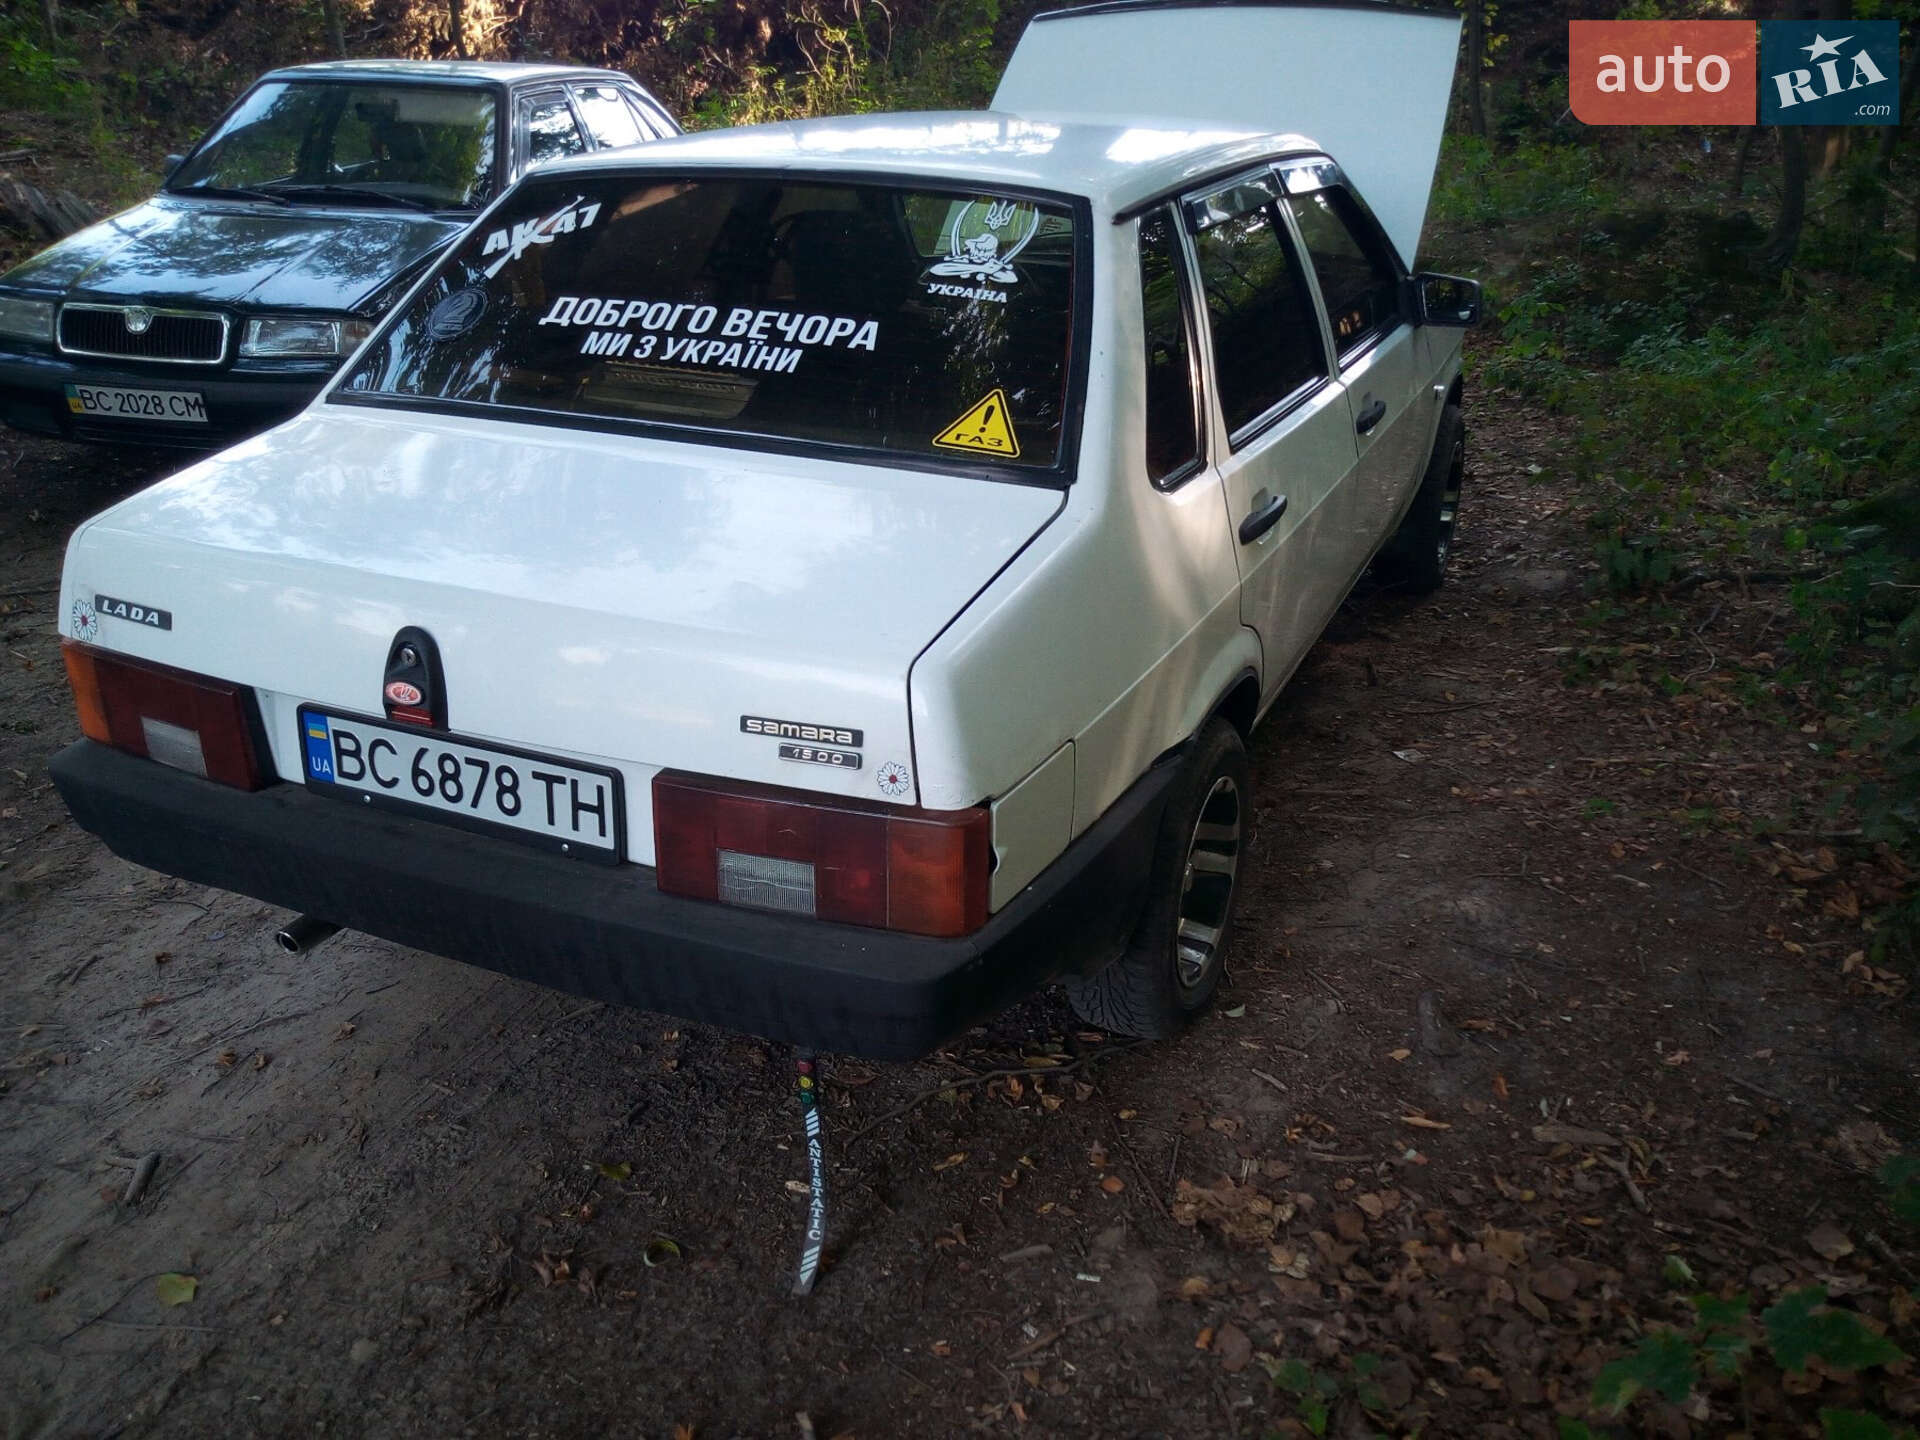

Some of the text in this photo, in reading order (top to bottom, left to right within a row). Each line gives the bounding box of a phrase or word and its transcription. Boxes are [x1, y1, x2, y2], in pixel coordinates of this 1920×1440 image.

[538, 296, 879, 351] ДОБРОГО ВЕЧОРА
[580, 331, 634, 357] МИ
[659, 337, 803, 374] УКРАЇНИ
[79, 388, 206, 418] BC 2028 CM
[955, 433, 1004, 447] ГАЗ
[102, 599, 160, 625] LADA
[311, 758, 332, 775] UA
[792, 748, 844, 764] 1500
[332, 728, 608, 838] BC 6878 TH
[807, 1138, 824, 1240] ANTISTATIC
